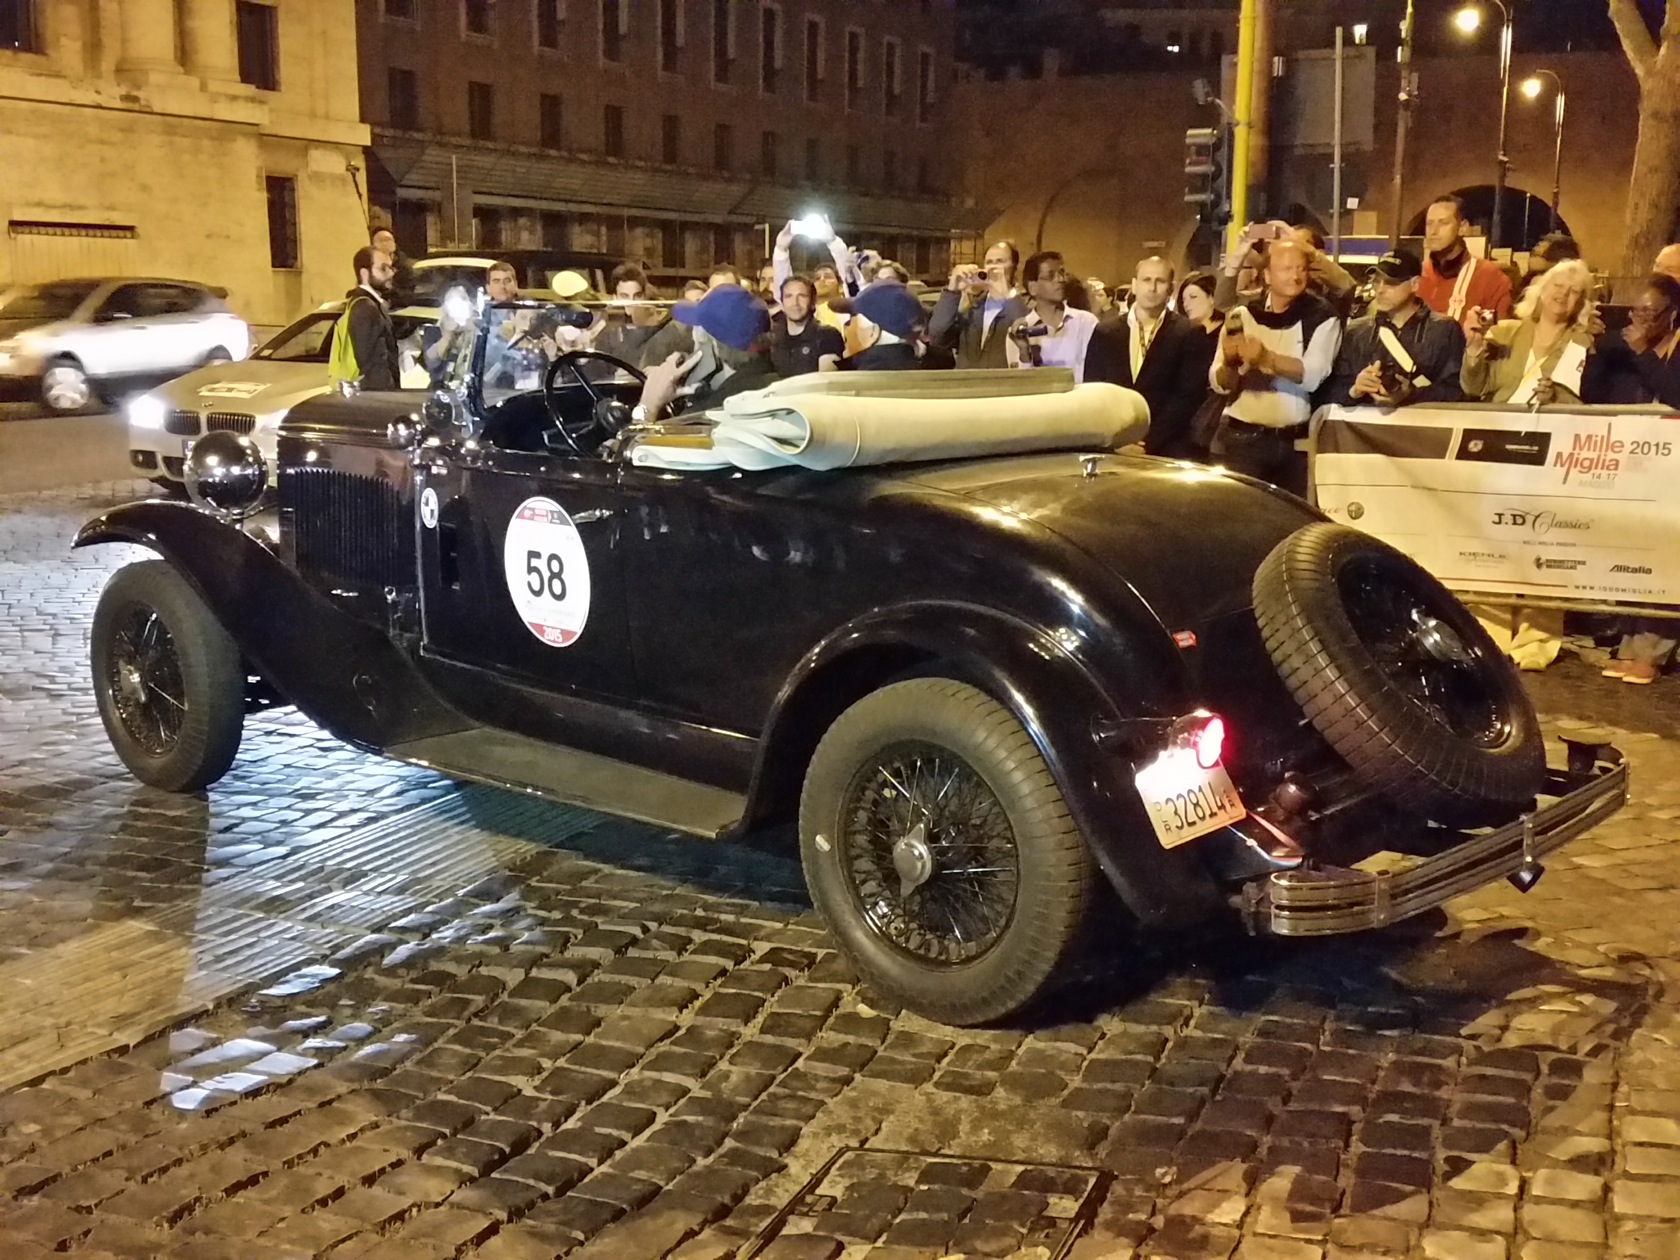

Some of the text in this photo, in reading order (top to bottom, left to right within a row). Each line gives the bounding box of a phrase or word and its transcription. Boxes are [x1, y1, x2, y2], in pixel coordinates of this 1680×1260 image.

[1572, 422, 1673, 457] Mille 2015
[1553, 451, 1621, 486] Miglia
[1491, 510, 1590, 536] J.D Classics
[526, 549, 567, 602] 58
[1609, 564, 1653, 575] Alitalia
[542, 625, 563, 642] 2015
[1165, 781, 1229, 831] 32814
